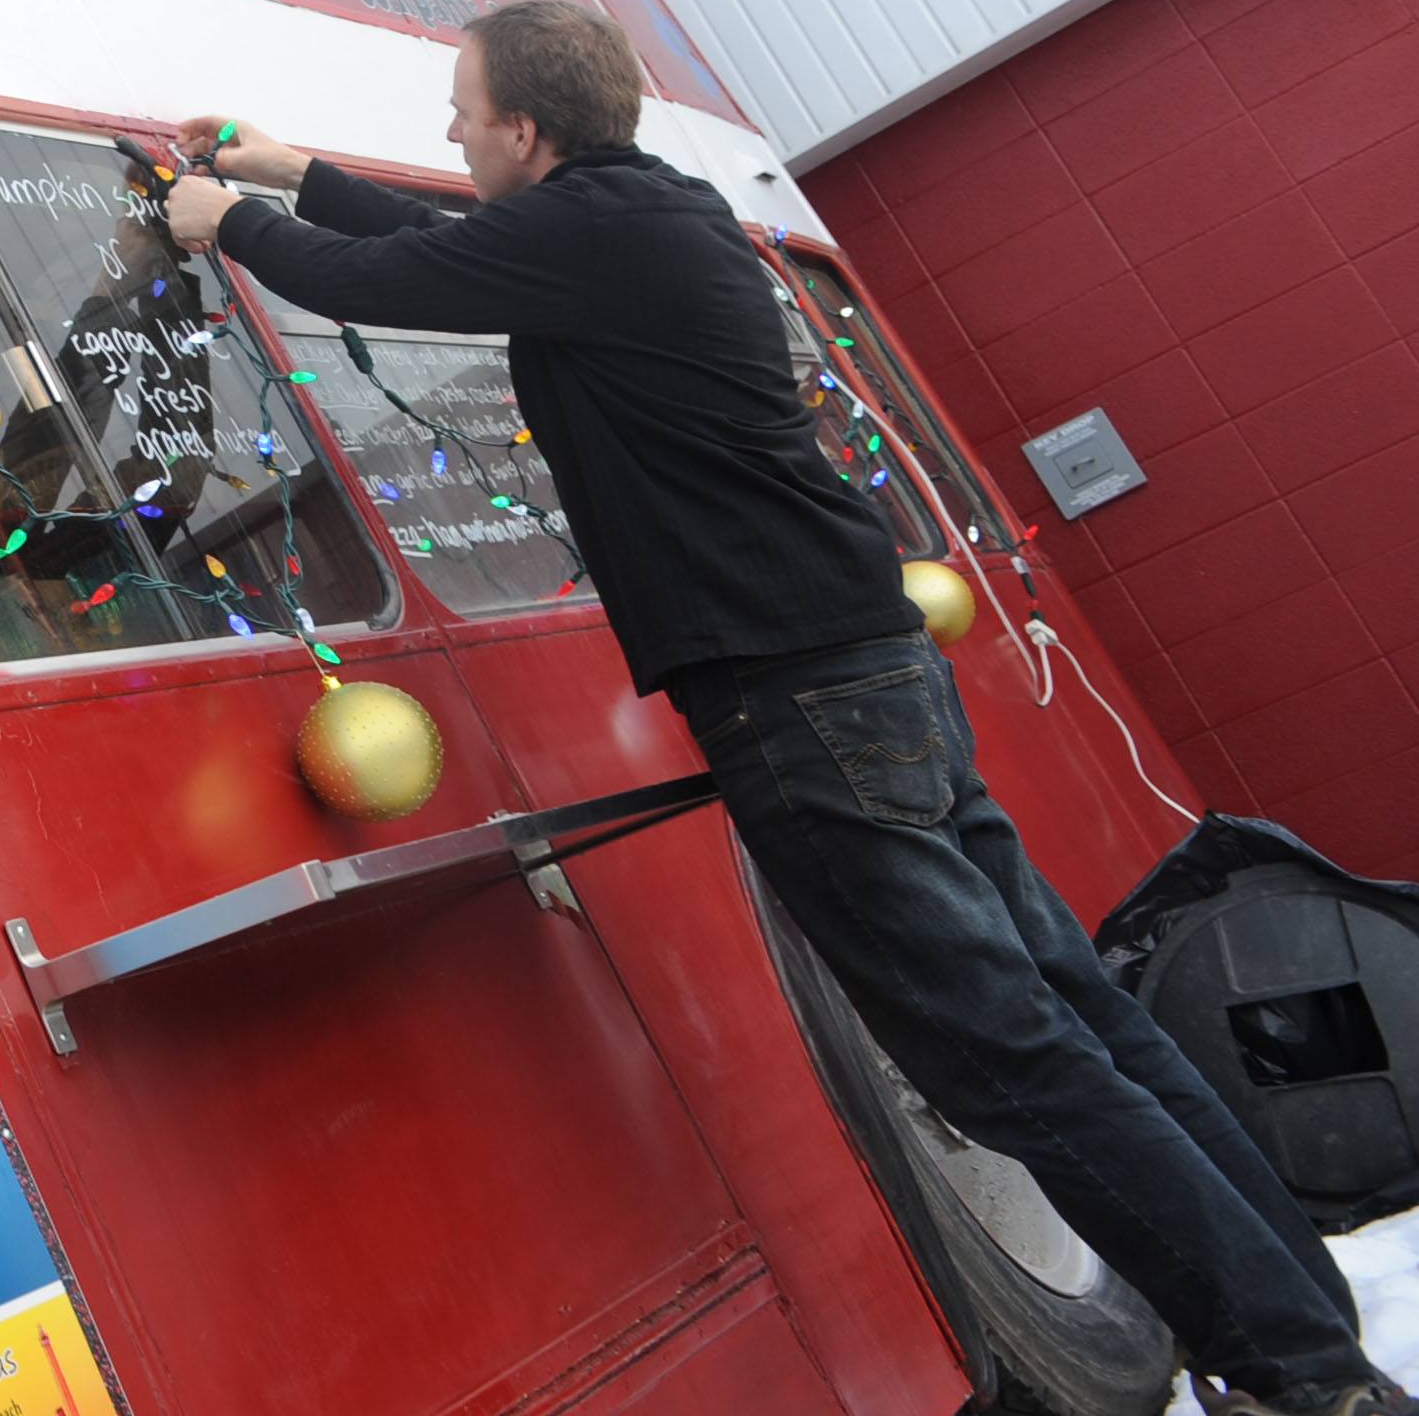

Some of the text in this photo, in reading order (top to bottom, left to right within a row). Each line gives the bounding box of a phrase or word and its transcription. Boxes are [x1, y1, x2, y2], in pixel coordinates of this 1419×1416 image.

[112, 184, 169, 227] spic
[136, 376, 222, 418] fresh
[135, 417, 214, 487] grated
[213, 416, 302, 477] nutmg
